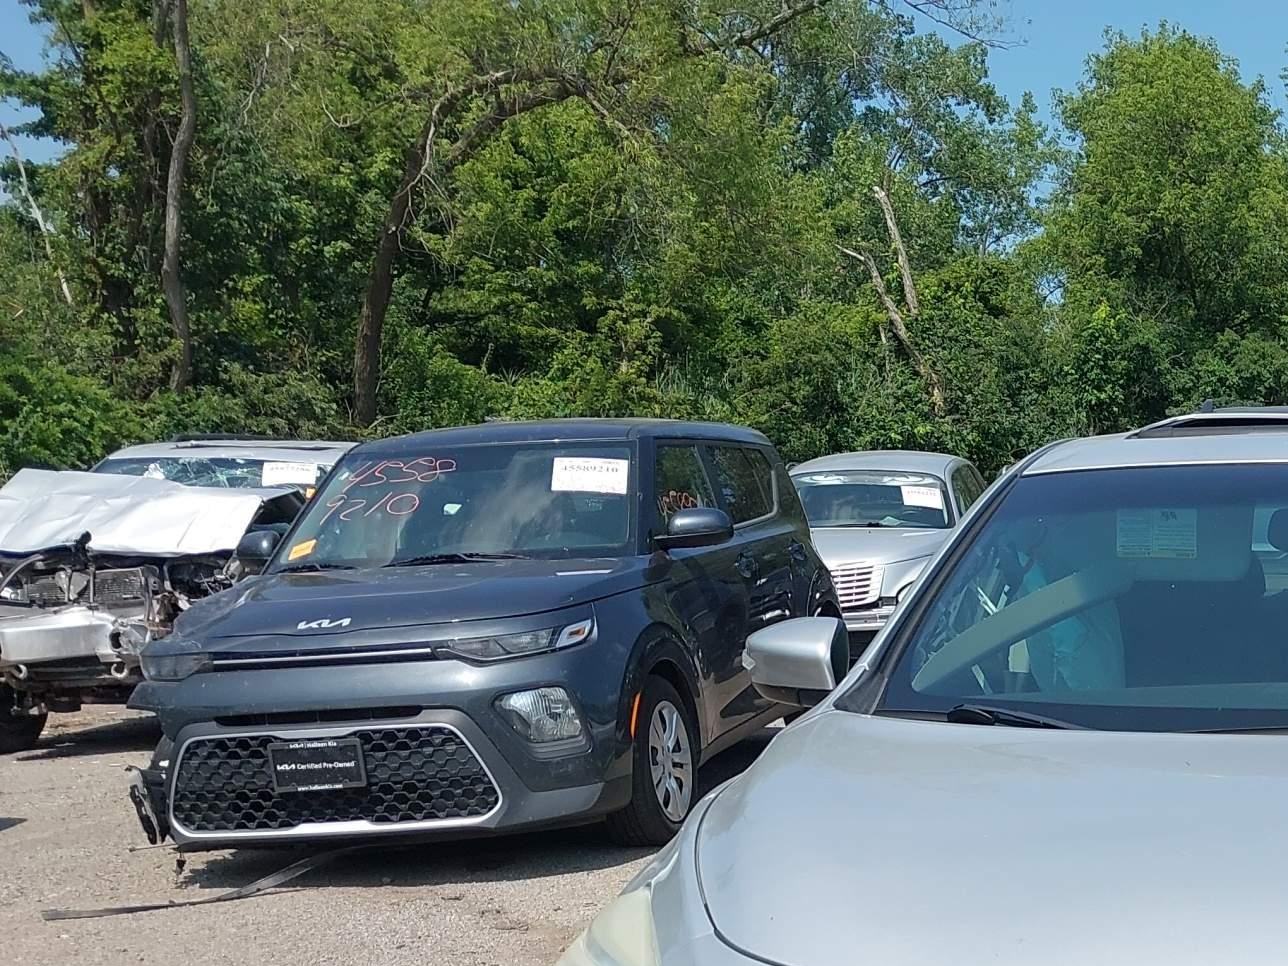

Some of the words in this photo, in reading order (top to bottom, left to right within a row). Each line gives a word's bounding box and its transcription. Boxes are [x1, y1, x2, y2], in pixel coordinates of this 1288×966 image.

[342, 457, 457, 493] 4558
[319, 491, 420, 526] 9210
[297, 761, 322, 770] Certified
